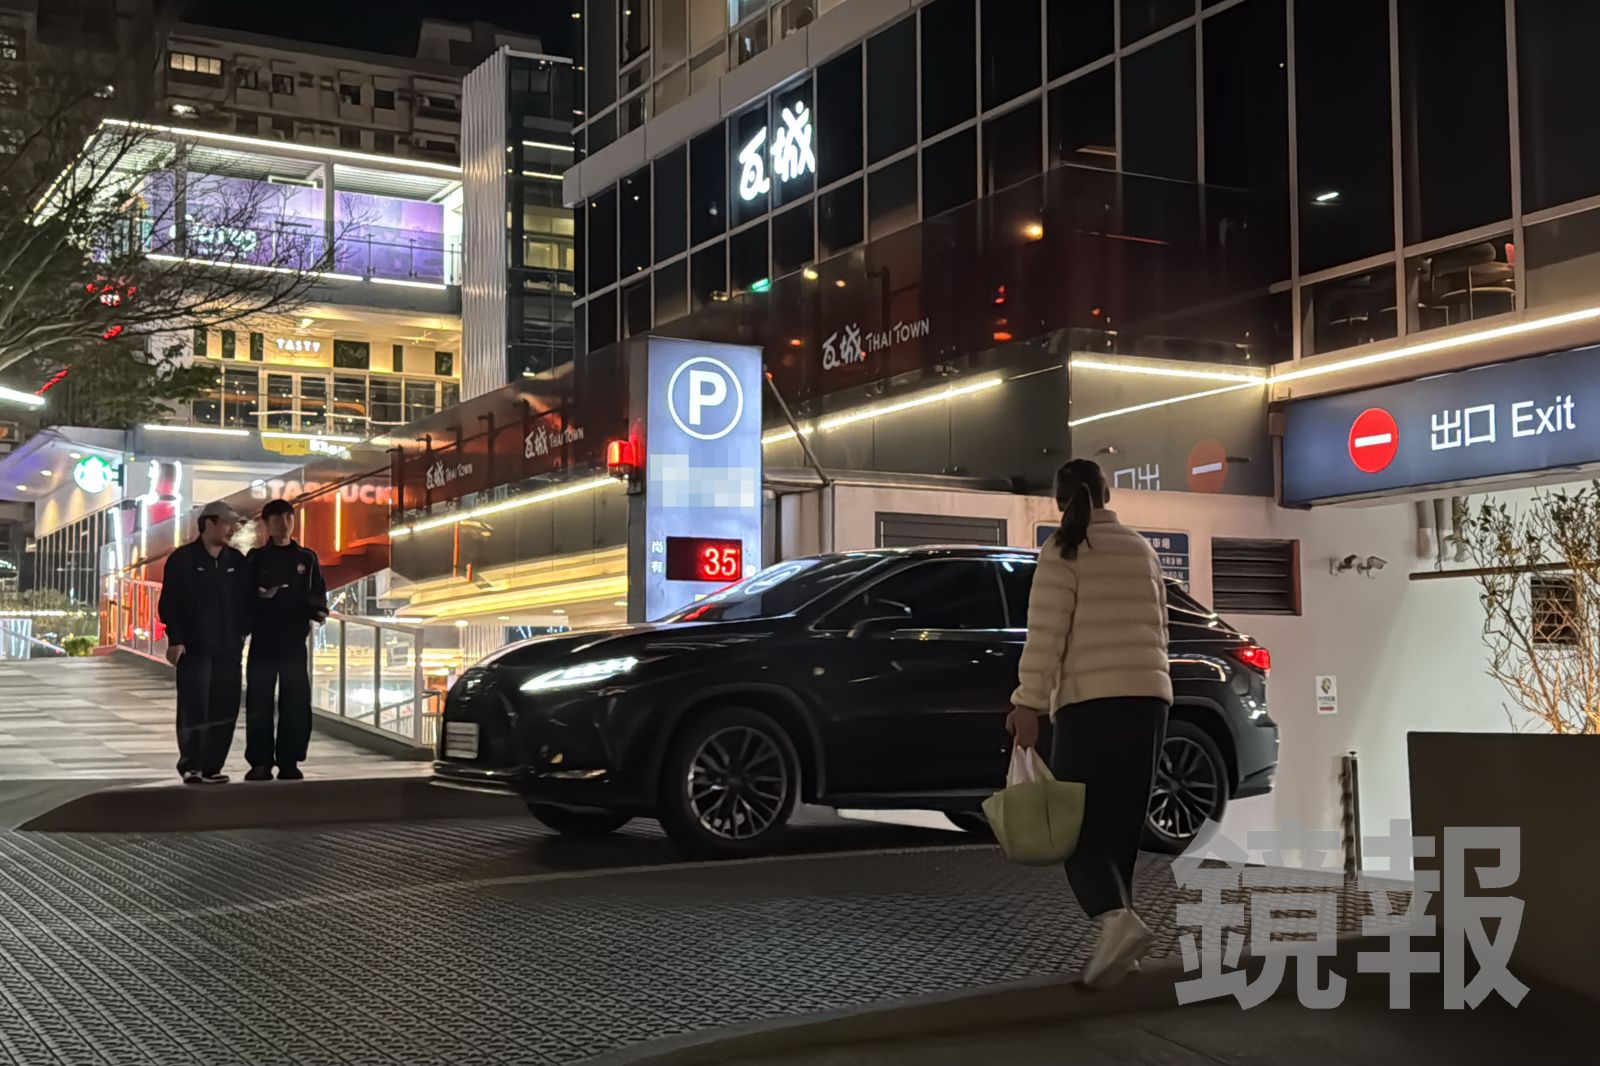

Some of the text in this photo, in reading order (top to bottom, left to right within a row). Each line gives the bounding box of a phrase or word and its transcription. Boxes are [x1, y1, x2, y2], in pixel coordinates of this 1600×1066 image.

[739, 101, 815, 200] 瓦城
[276, 338, 321, 352] TASTY
[822, 318, 930, 370] 瓦城 THAI TOWN
[689, 369, 727, 426] P
[525, 425, 584, 459] 瓦城 THAI TOWN
[1431, 394, 1576, 450] 出口 Exit
[426, 461, 446, 490] 瓦城
[704, 548, 737, 576] 35
